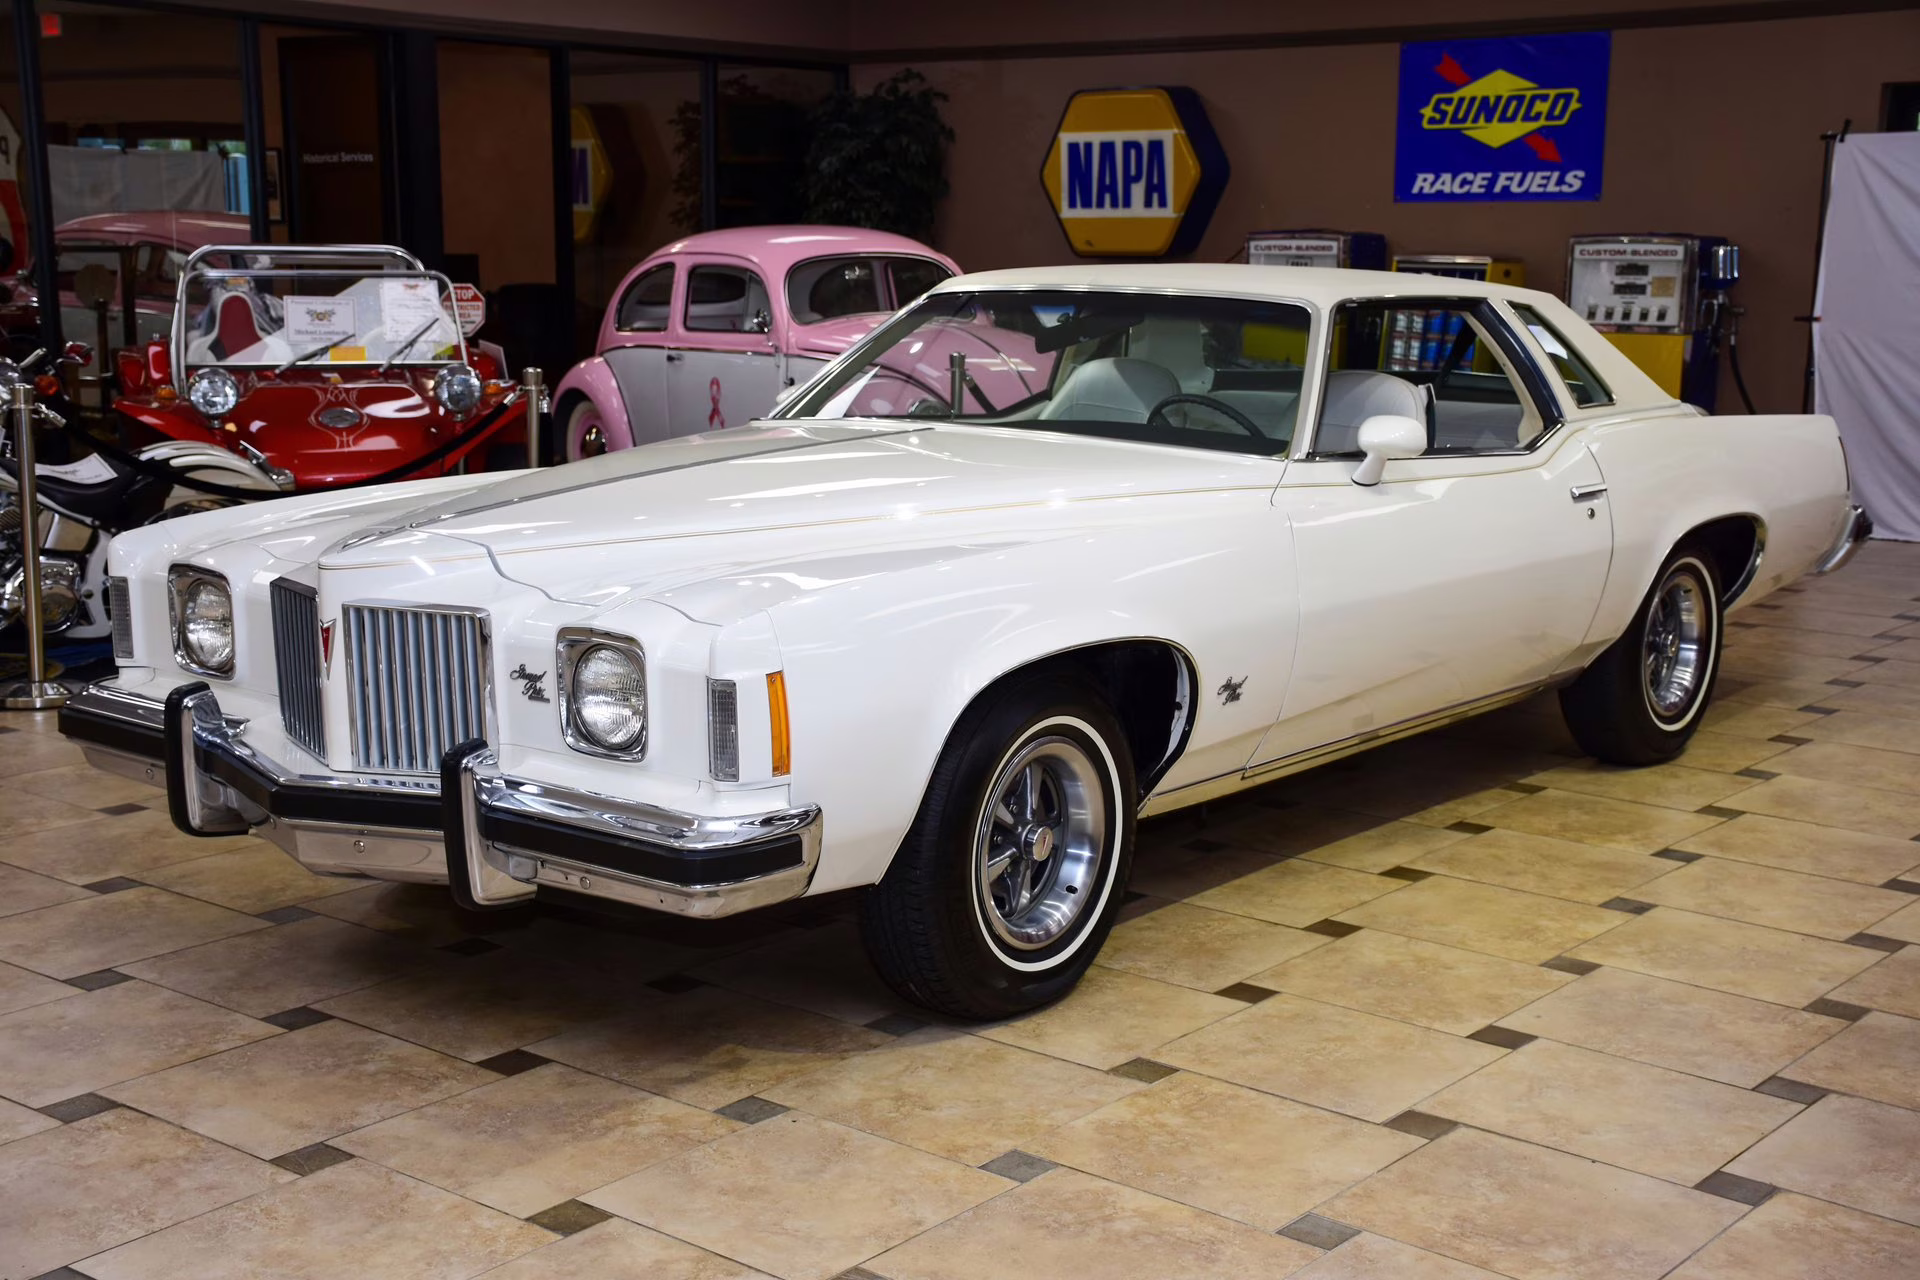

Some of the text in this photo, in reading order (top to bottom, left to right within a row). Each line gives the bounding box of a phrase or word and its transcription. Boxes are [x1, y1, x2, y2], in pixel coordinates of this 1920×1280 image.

[1427, 92, 1575, 124] SUNOCO
[303, 151, 374, 164] Historical Services
[1067, 139, 1167, 209] NAPA
[1411, 169, 1586, 194] RACE FUELS
[455, 289, 475, 300] TOP
